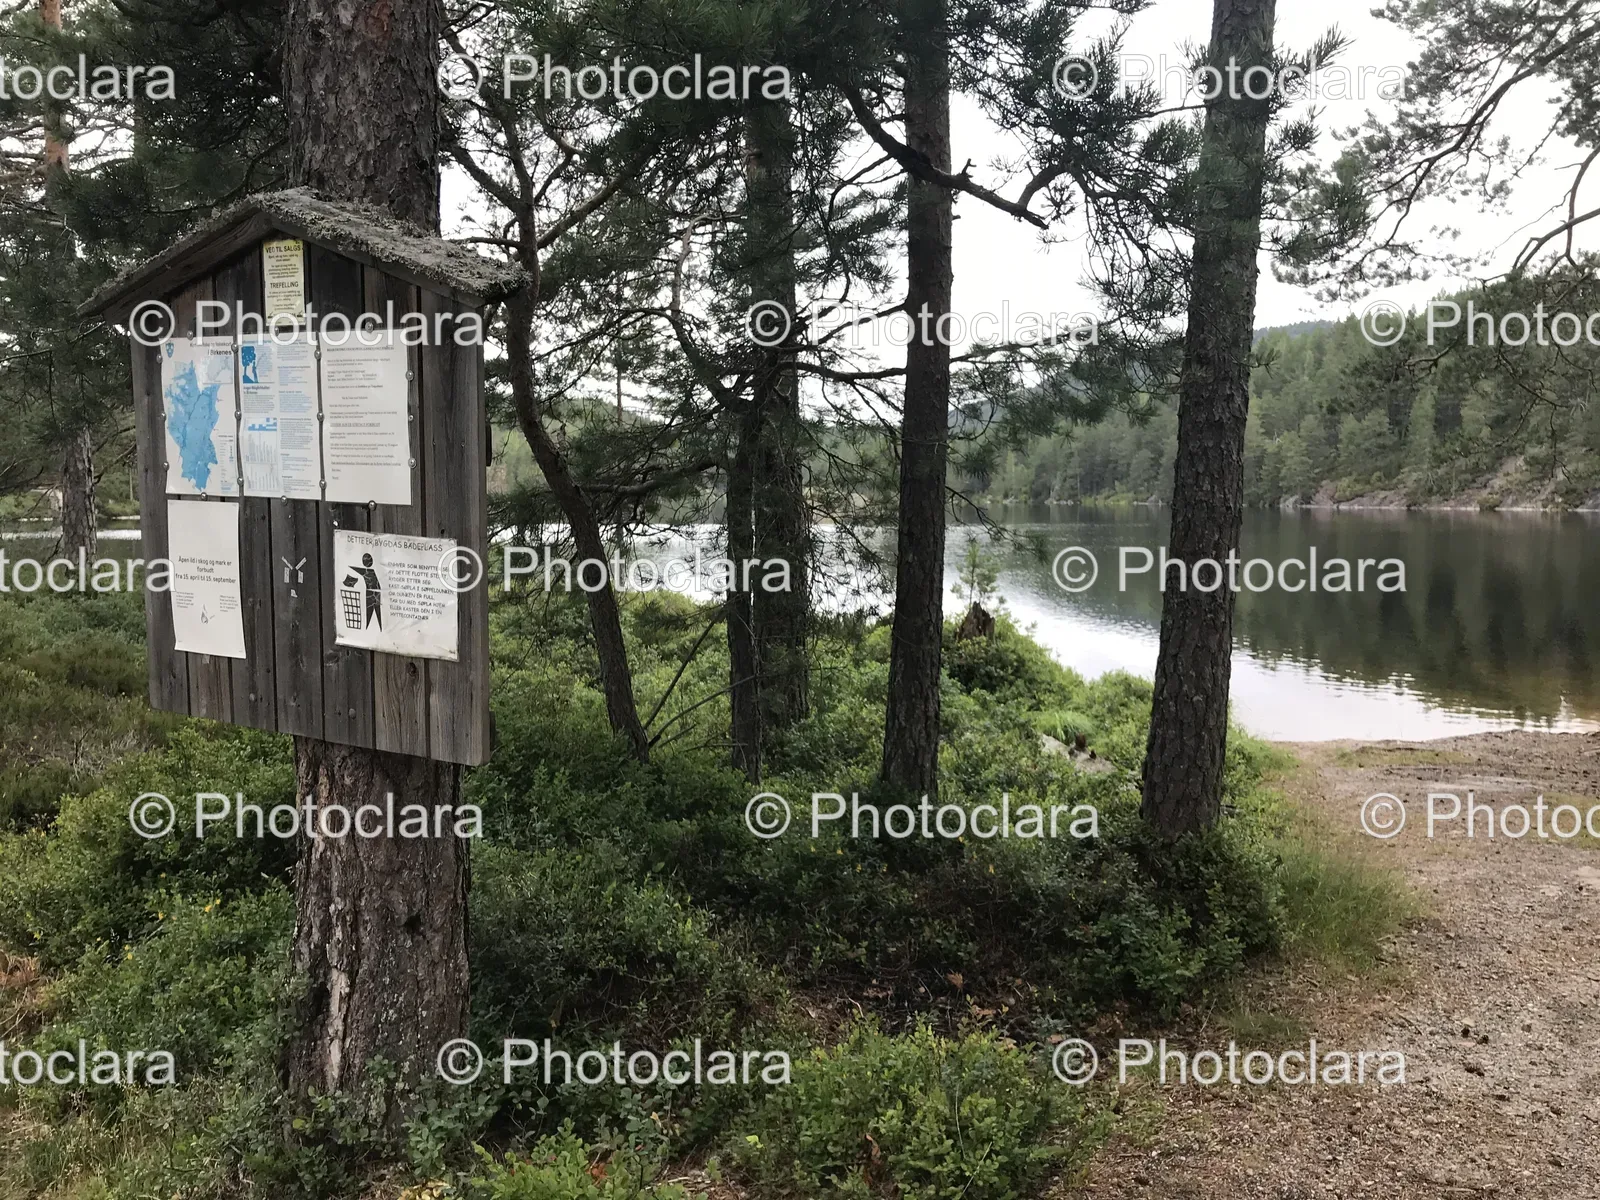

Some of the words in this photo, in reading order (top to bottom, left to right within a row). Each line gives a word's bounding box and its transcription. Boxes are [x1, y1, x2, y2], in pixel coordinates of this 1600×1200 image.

[347, 535, 364, 544] DETTE
[374, 539, 402, 549] BYGDAS
[178, 555, 189, 563] Åpen
